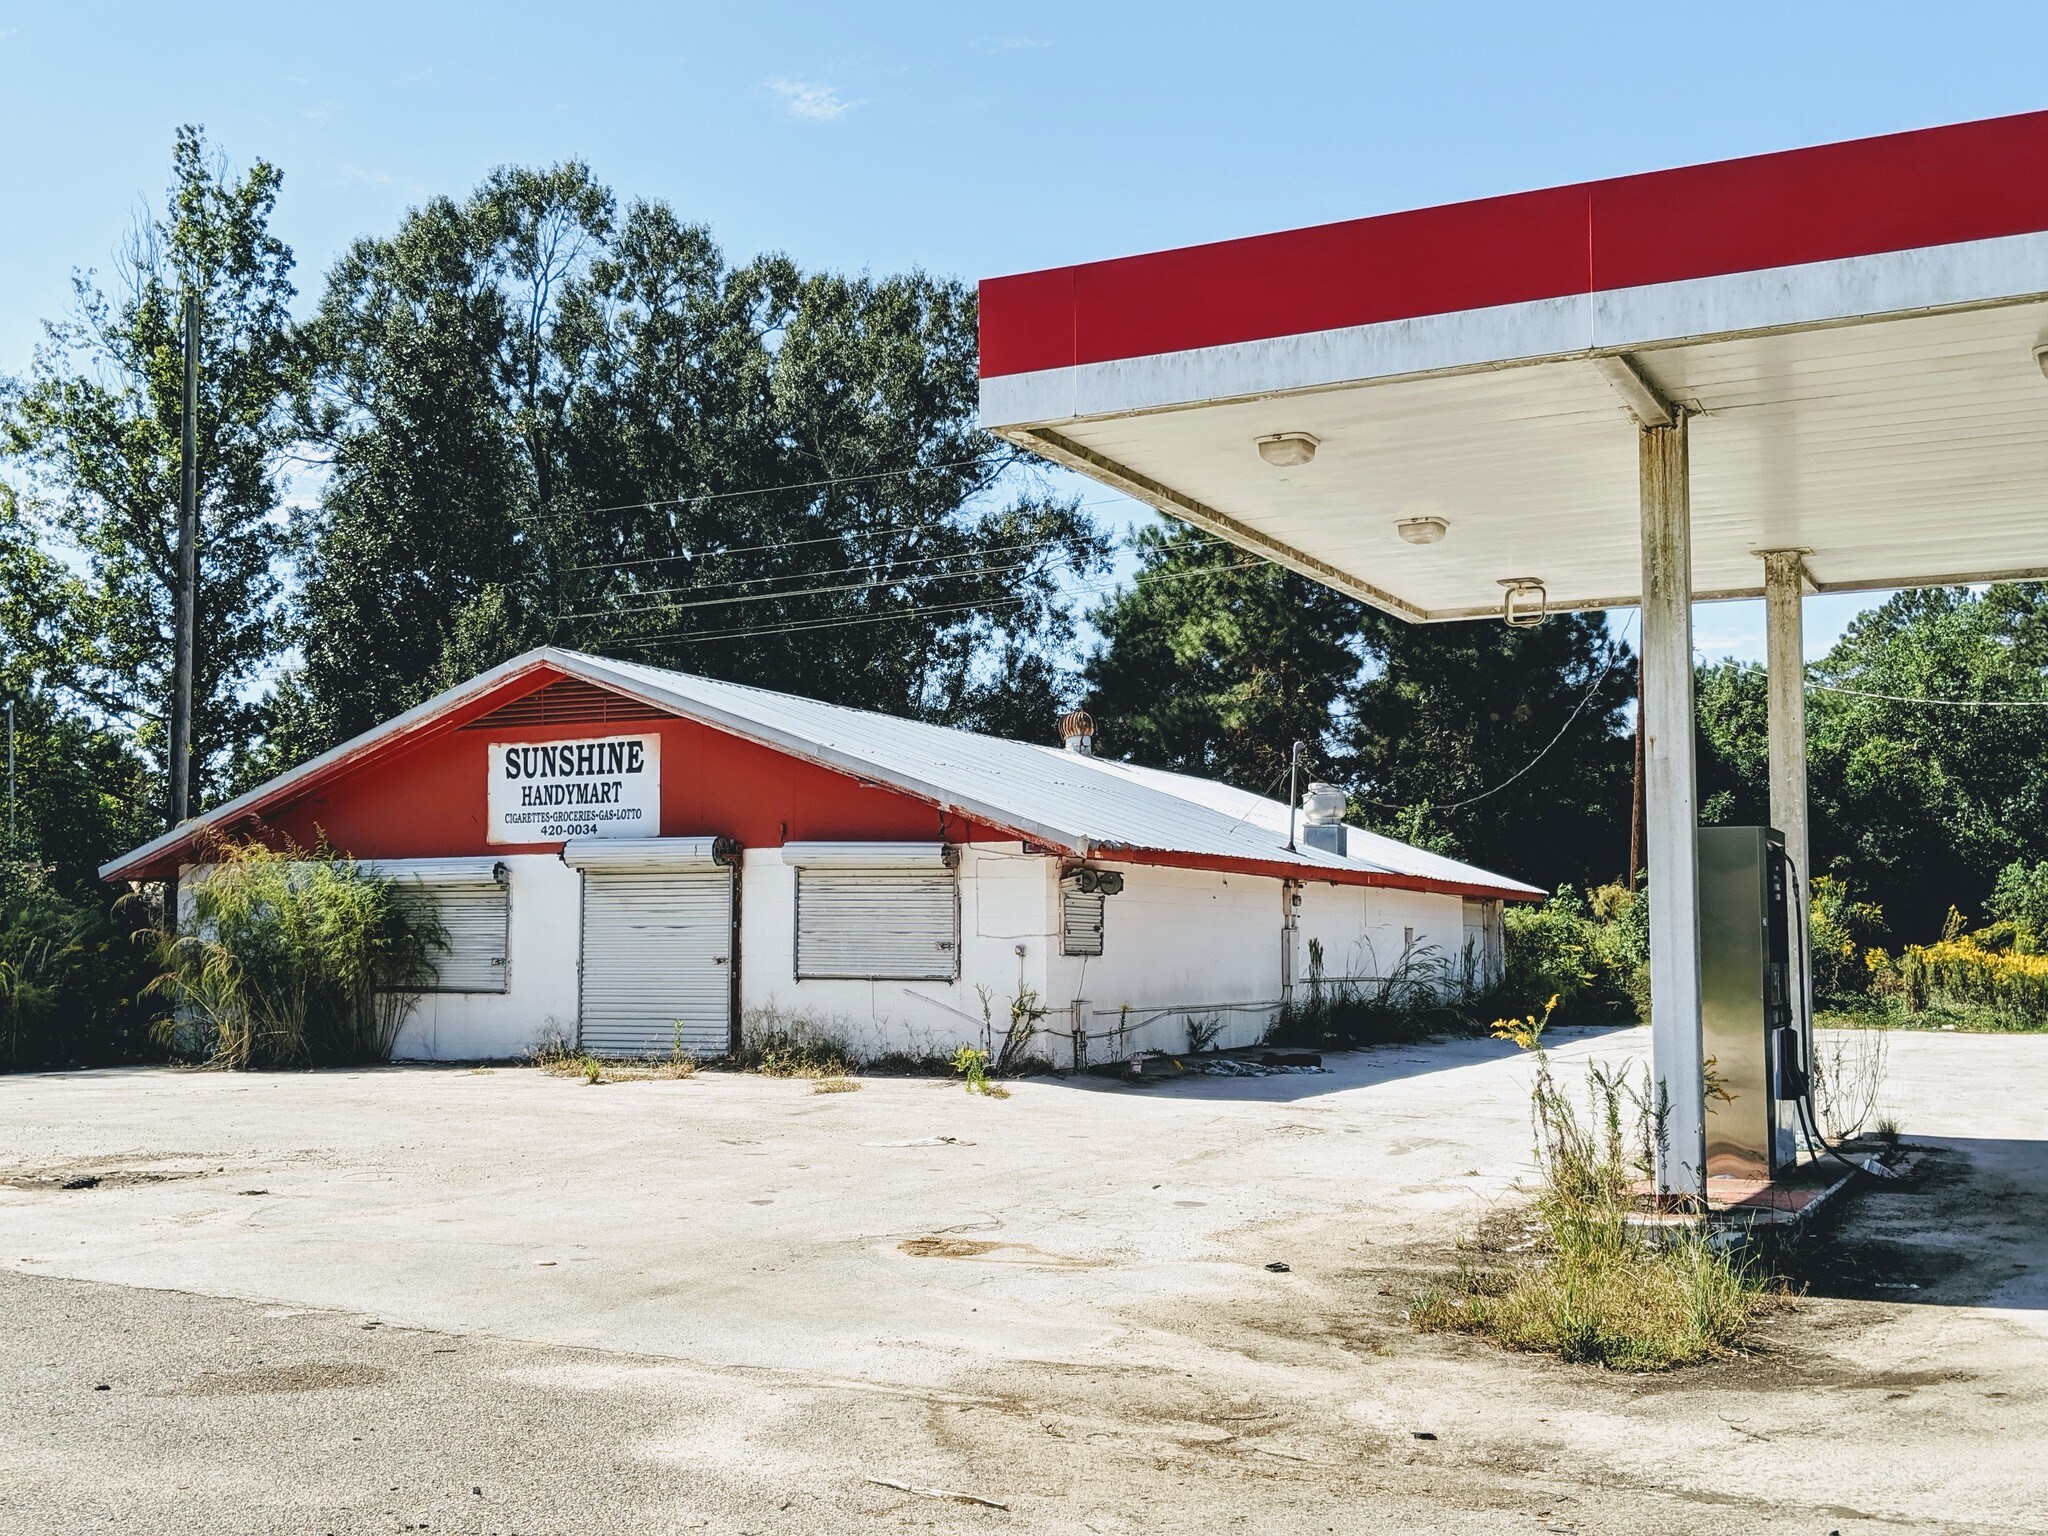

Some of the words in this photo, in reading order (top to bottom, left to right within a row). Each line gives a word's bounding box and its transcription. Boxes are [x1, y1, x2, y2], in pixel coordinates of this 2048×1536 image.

[505, 740, 644, 779] SUNSHINE
[521, 781, 622, 806] HANDYMART
[540, 824, 598, 836] 420-0034
